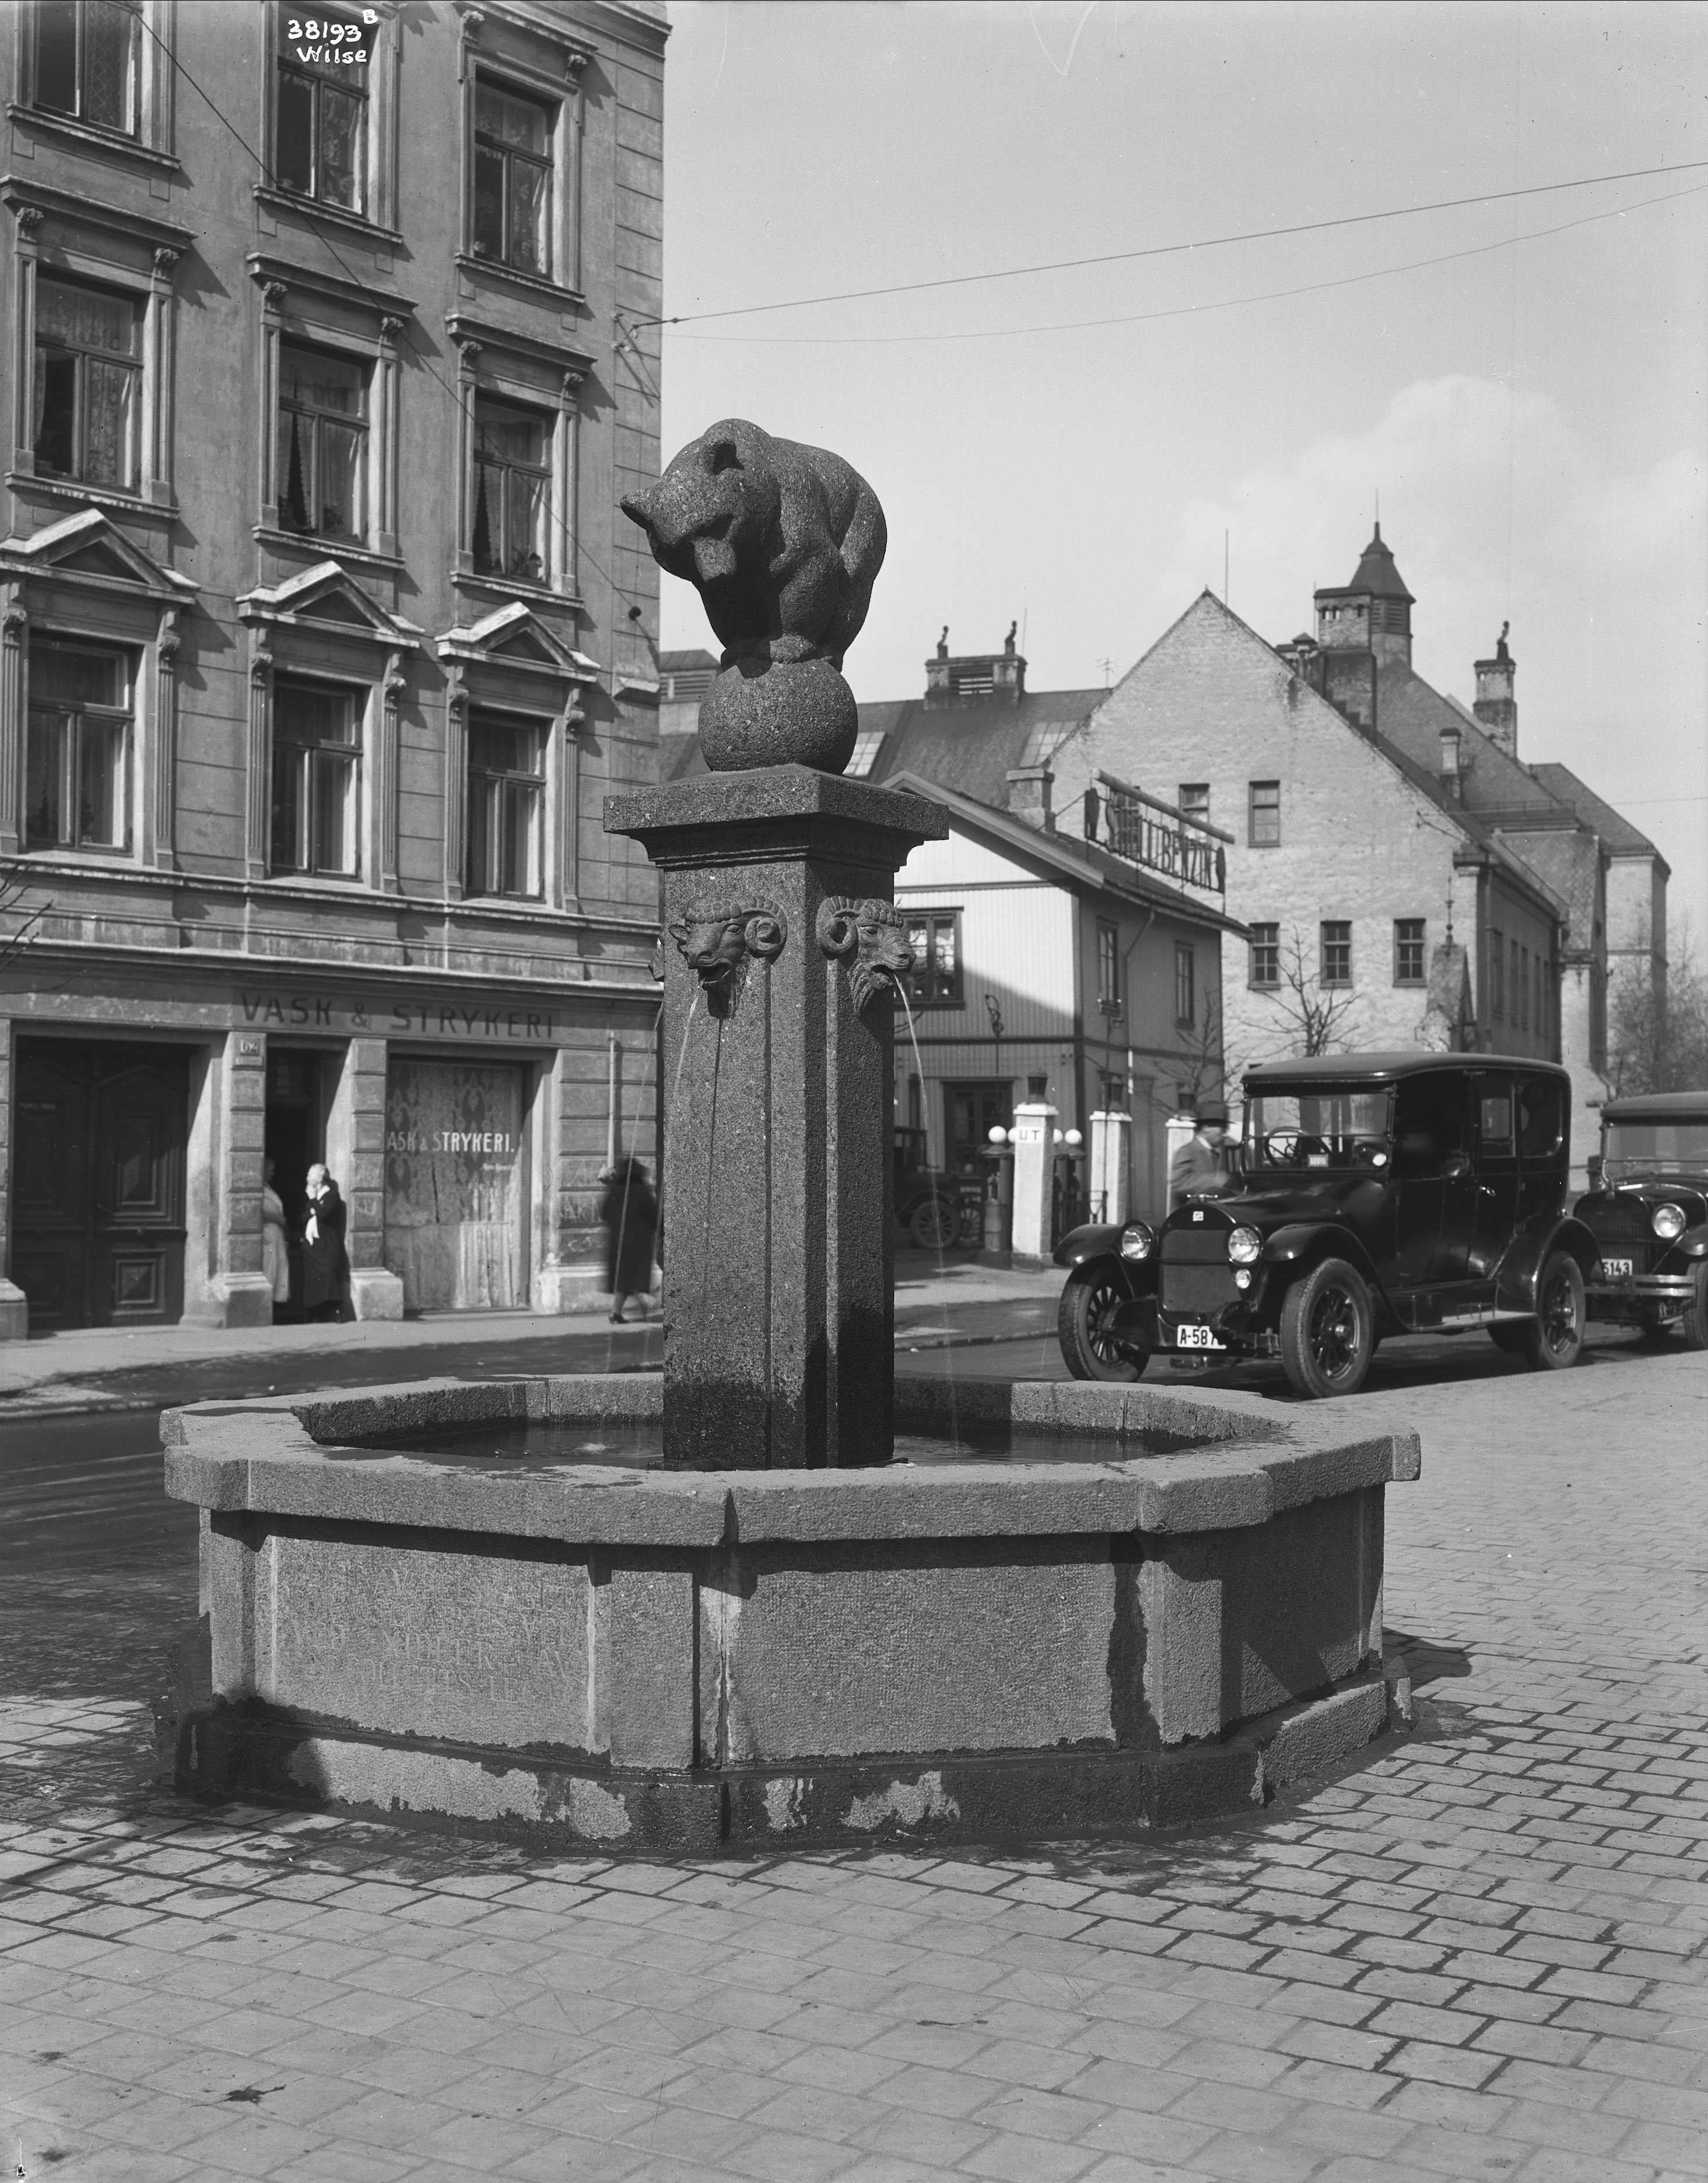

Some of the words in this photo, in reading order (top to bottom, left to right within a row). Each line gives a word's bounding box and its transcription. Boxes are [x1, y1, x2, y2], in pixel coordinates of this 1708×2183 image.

[240, 992, 332, 1026] VASK
[351, 1001, 371, 1031] &
[390, 1004, 553, 1040] STRYKERI
[432, 1131, 515, 1153] STRYKERI.
[1019, 1129, 1040, 1141] UT
[373, 1567, 409, 1597] AV
[522, 1613, 574, 1647] VEL
[380, 1629, 496, 1670] MIDLER
